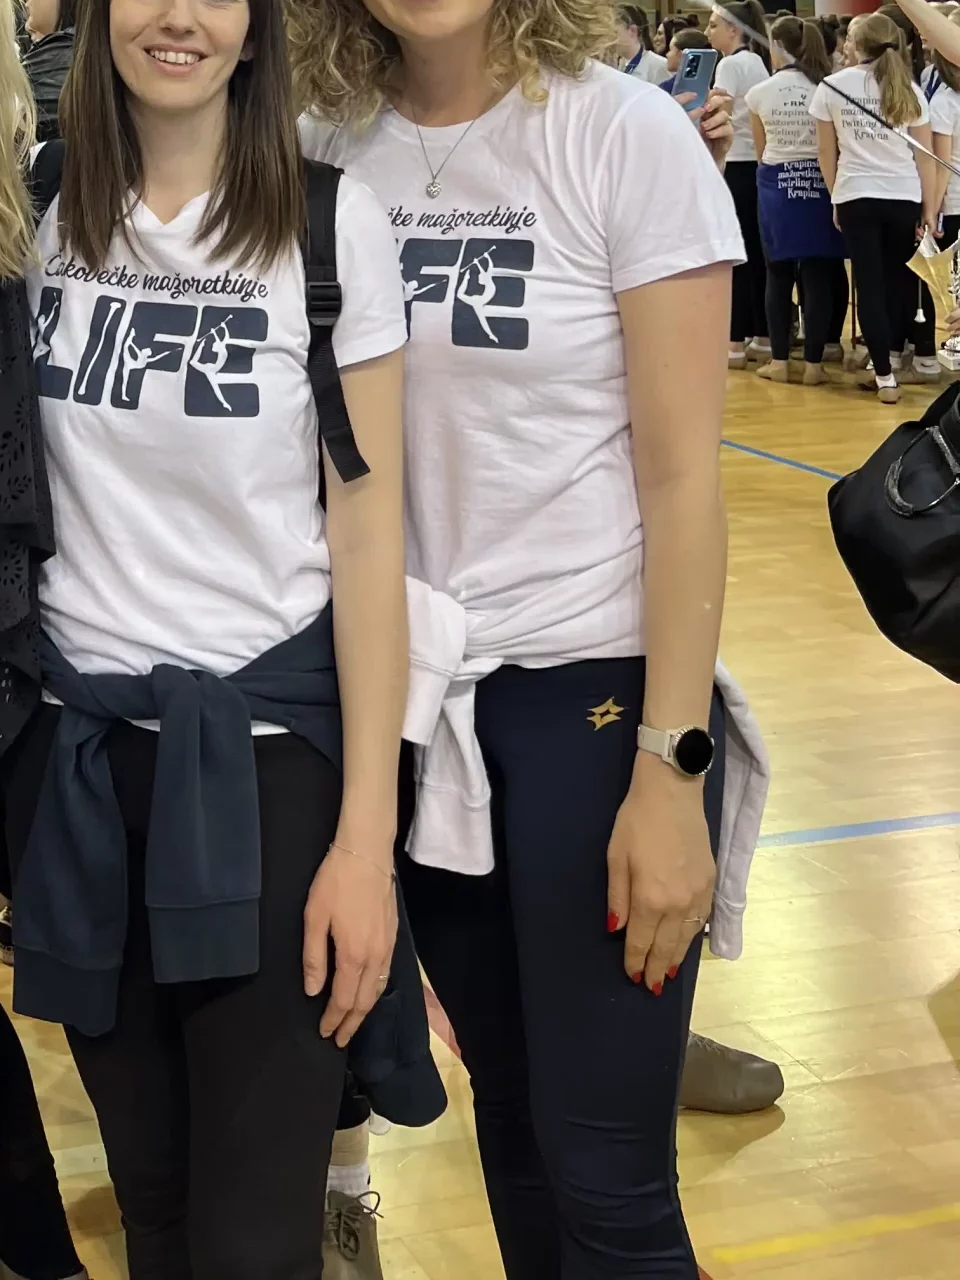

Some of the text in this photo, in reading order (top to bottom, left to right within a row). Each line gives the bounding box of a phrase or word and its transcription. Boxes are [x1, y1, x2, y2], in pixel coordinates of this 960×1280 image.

[417, 205, 538, 235] mažoretkinje
[44, 248, 269, 302] Čakovečke mažoretkinje
[33, 286, 269, 418] LIFE
